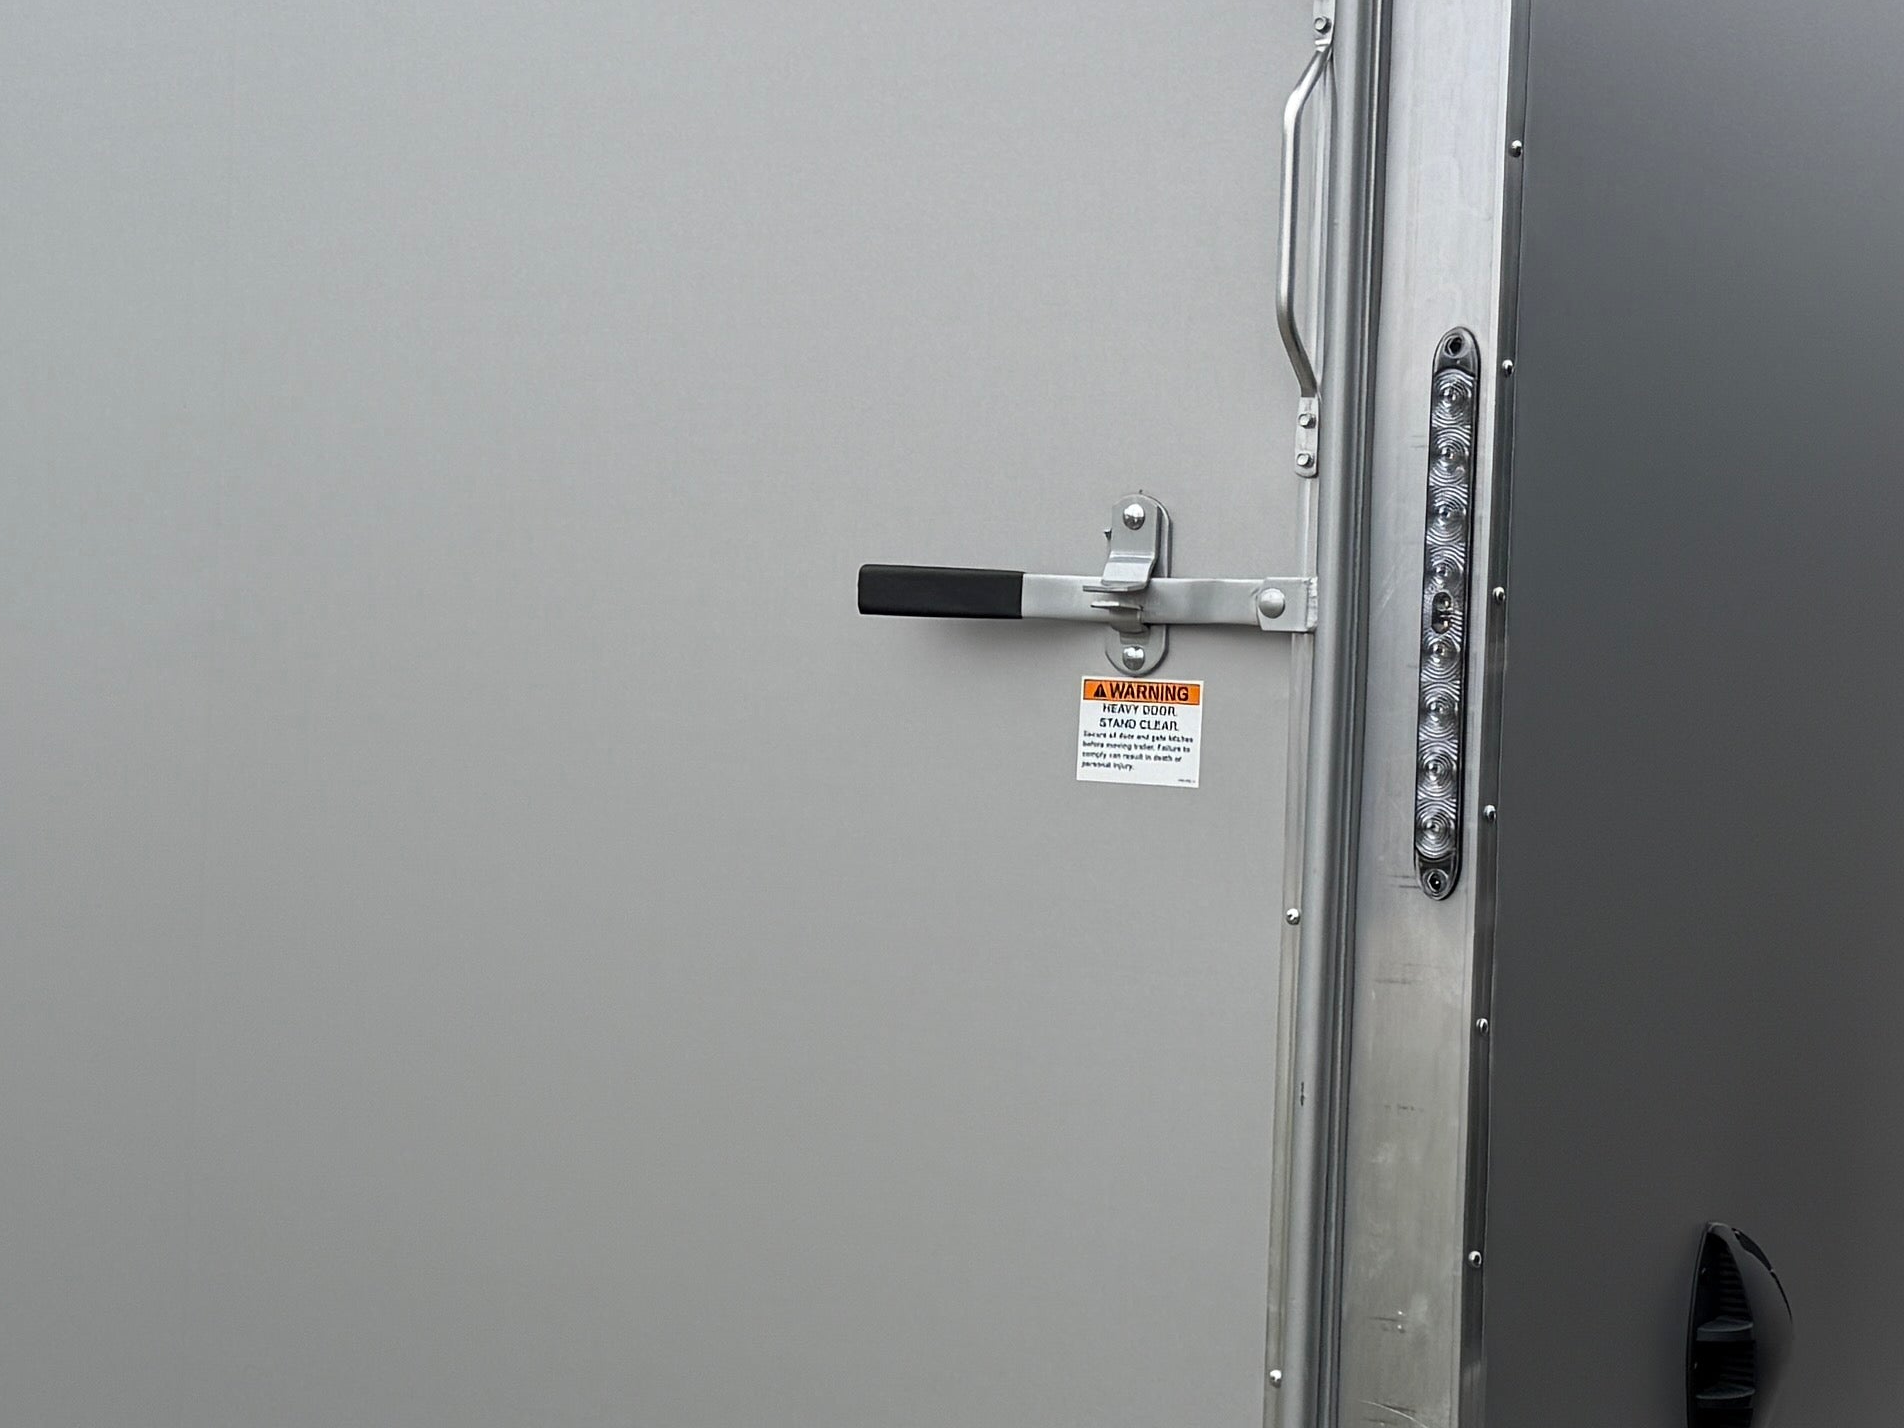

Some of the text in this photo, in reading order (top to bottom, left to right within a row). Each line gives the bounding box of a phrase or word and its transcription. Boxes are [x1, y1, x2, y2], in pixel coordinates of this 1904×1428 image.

[1110, 683, 1189, 701] WARNING
[1102, 703, 1139, 714] HEAVY
[1100, 717, 1179, 731] STAND CLEAR
